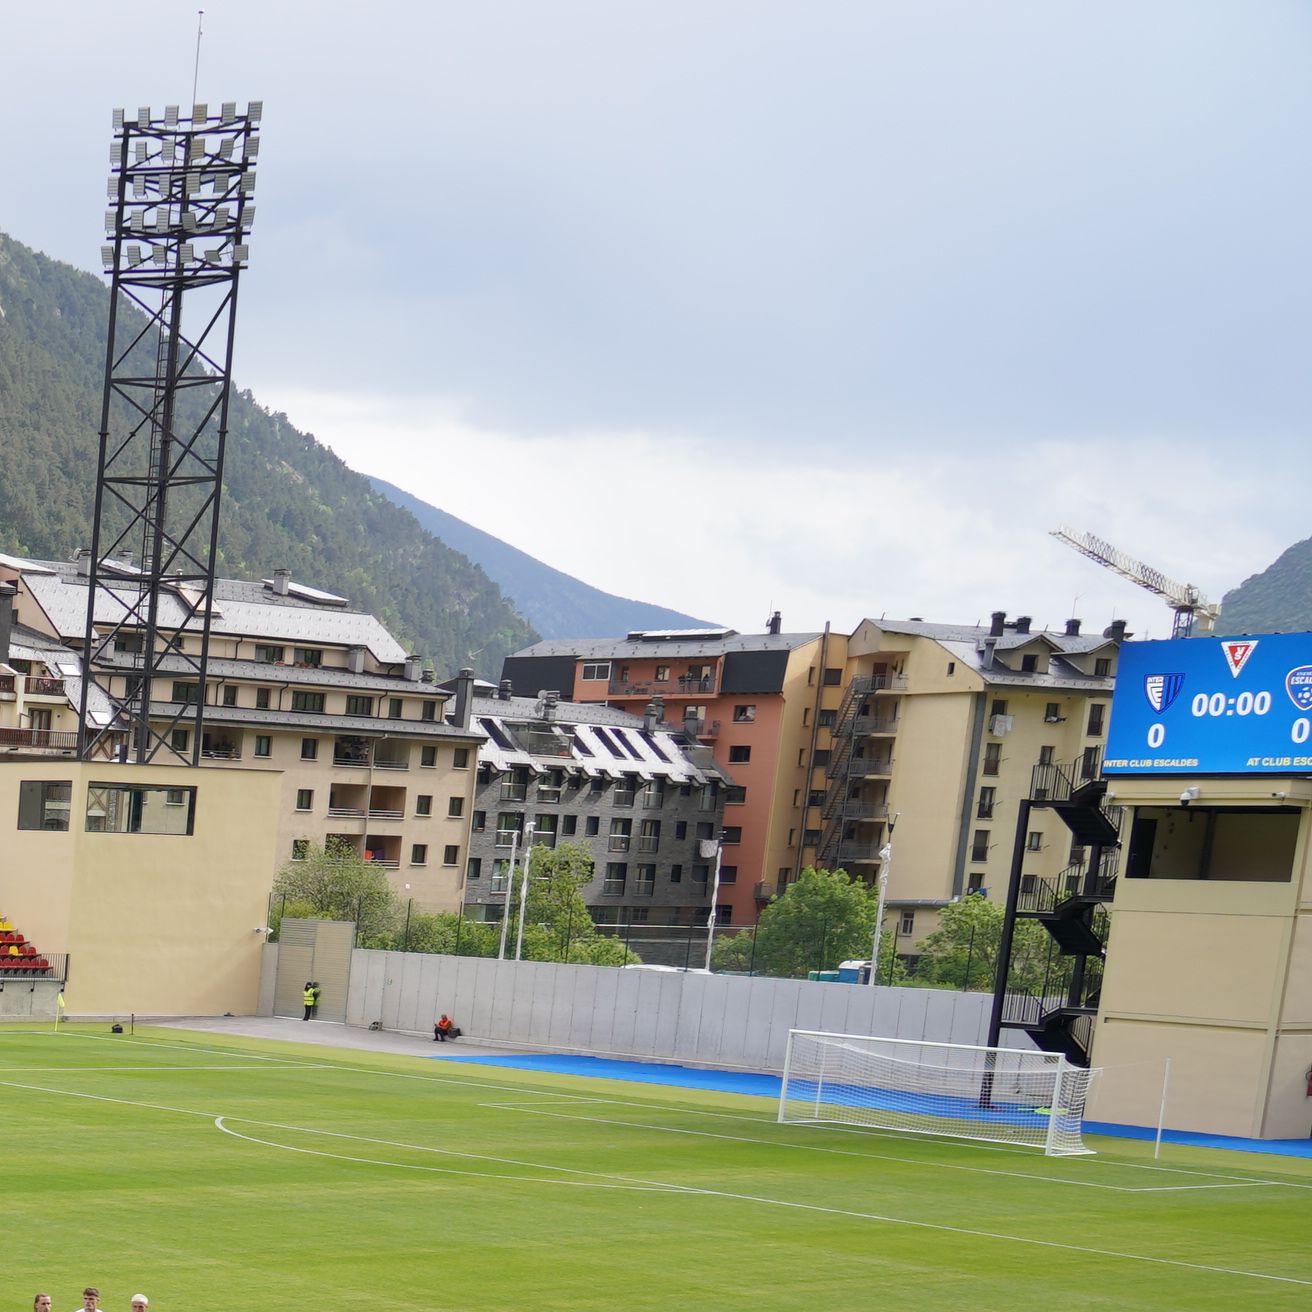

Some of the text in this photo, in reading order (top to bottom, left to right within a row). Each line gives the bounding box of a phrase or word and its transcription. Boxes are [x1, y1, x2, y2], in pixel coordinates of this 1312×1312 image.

[1191, 691, 1271, 717] 00:00
[1147, 723, 1165, 748] 0
[1291, 718, 1310, 744] 0
[1103, 758, 1199, 767] INTER CLUB ESCALDES
[1246, 757, 1261, 767] AT
[1262, 757, 1291, 767] CLUB
